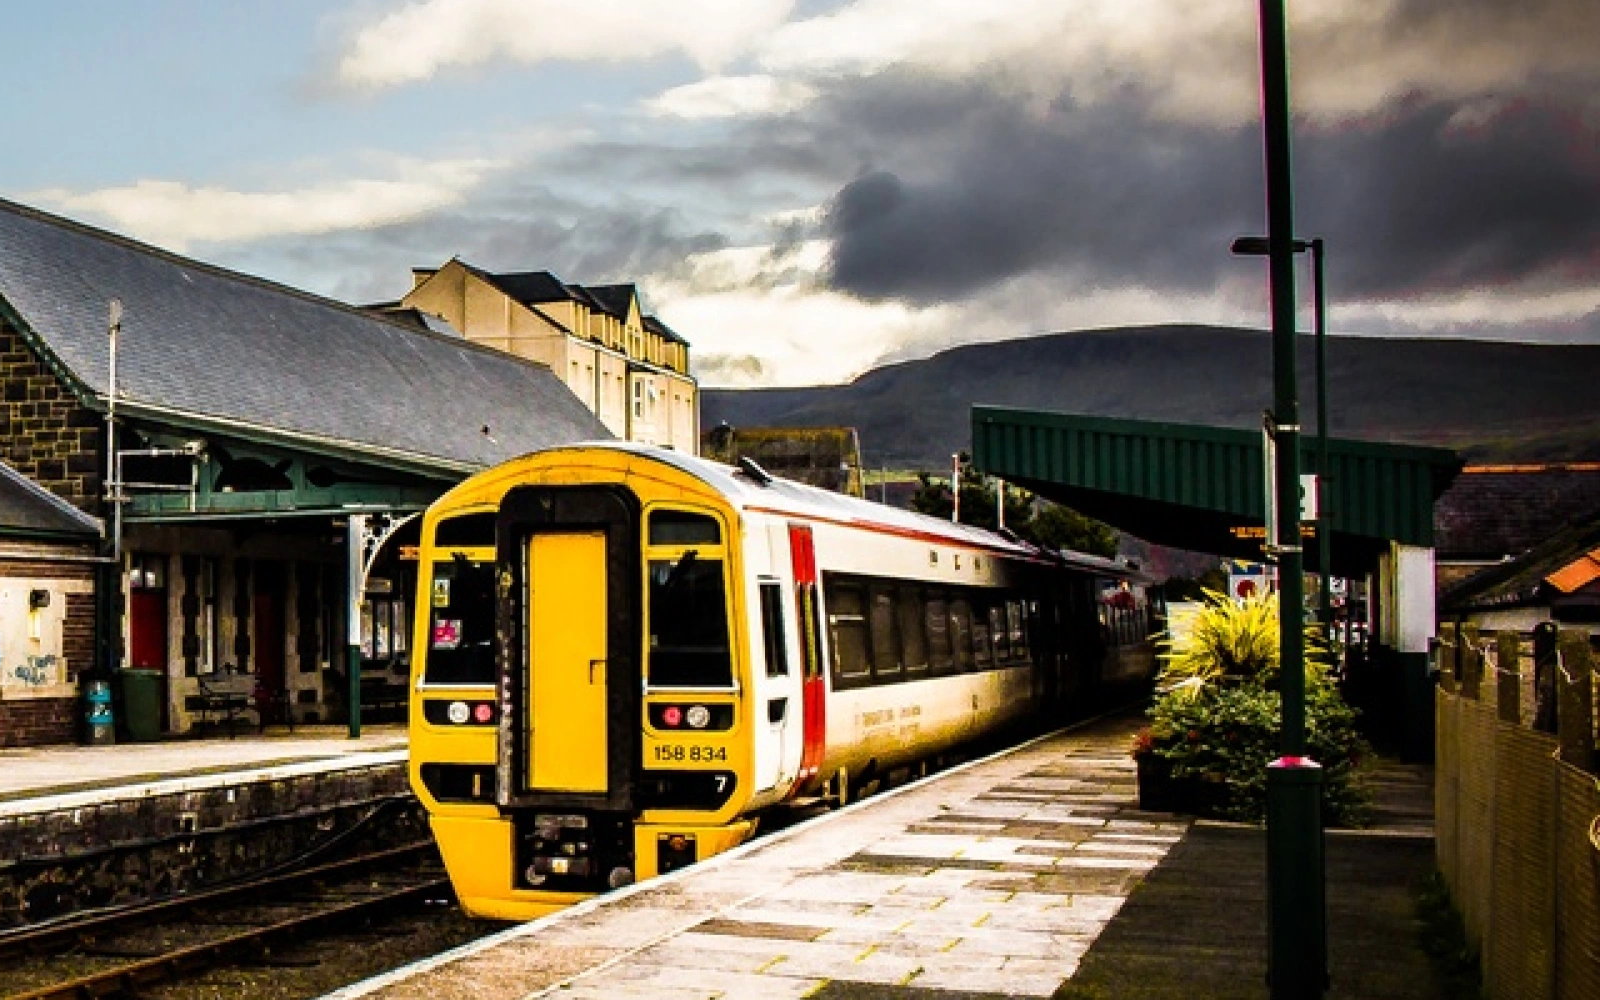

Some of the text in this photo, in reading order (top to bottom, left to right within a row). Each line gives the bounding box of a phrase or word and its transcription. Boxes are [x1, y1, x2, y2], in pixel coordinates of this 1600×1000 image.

[654, 745, 728, 762] 158 834
[714, 774, 728, 793] 7
